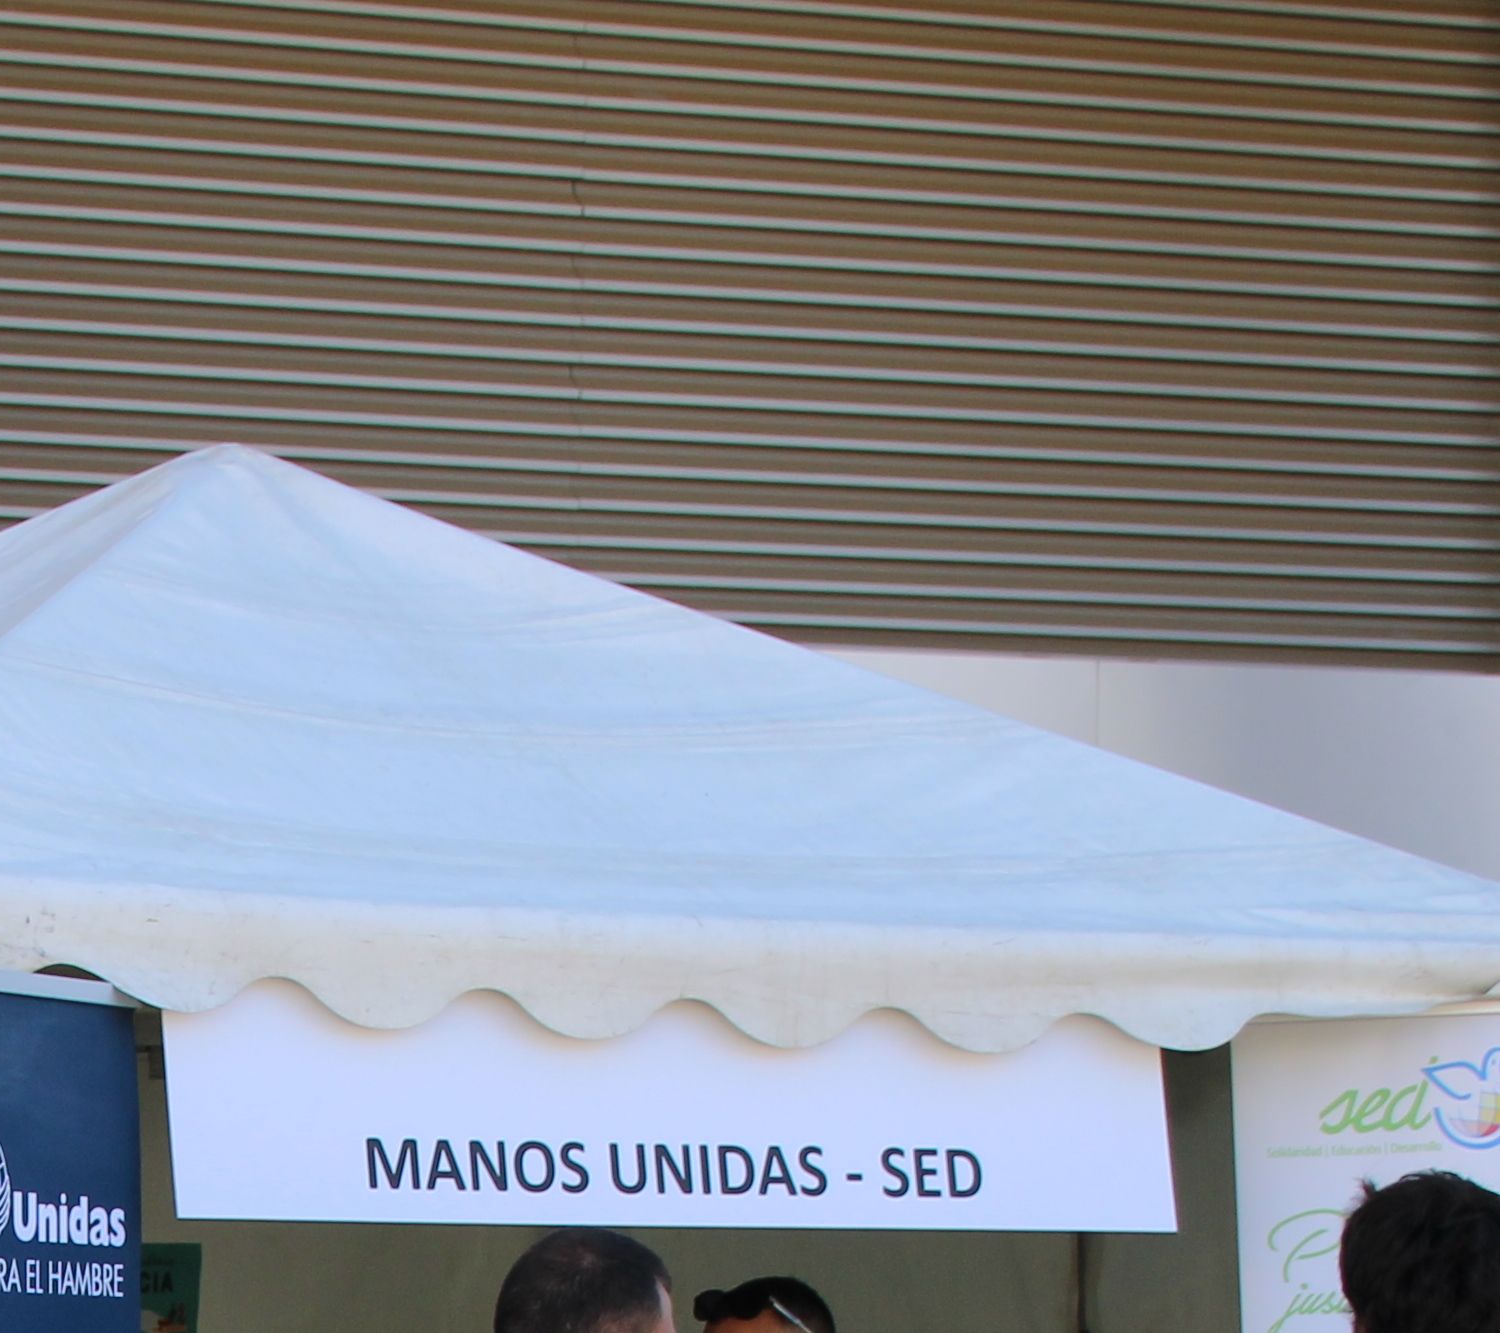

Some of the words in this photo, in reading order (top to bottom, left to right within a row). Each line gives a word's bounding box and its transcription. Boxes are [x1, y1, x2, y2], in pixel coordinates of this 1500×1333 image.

[365, 1137, 590, 1193] MANOS
[607, 1142, 828, 1197] UNIDAS
[880, 1146, 982, 1199] SED
[12, 1190, 126, 1247] Unidas
[25, 1259, 44, 1294] EL
[48, 1260, 124, 1297] HAMBRE
